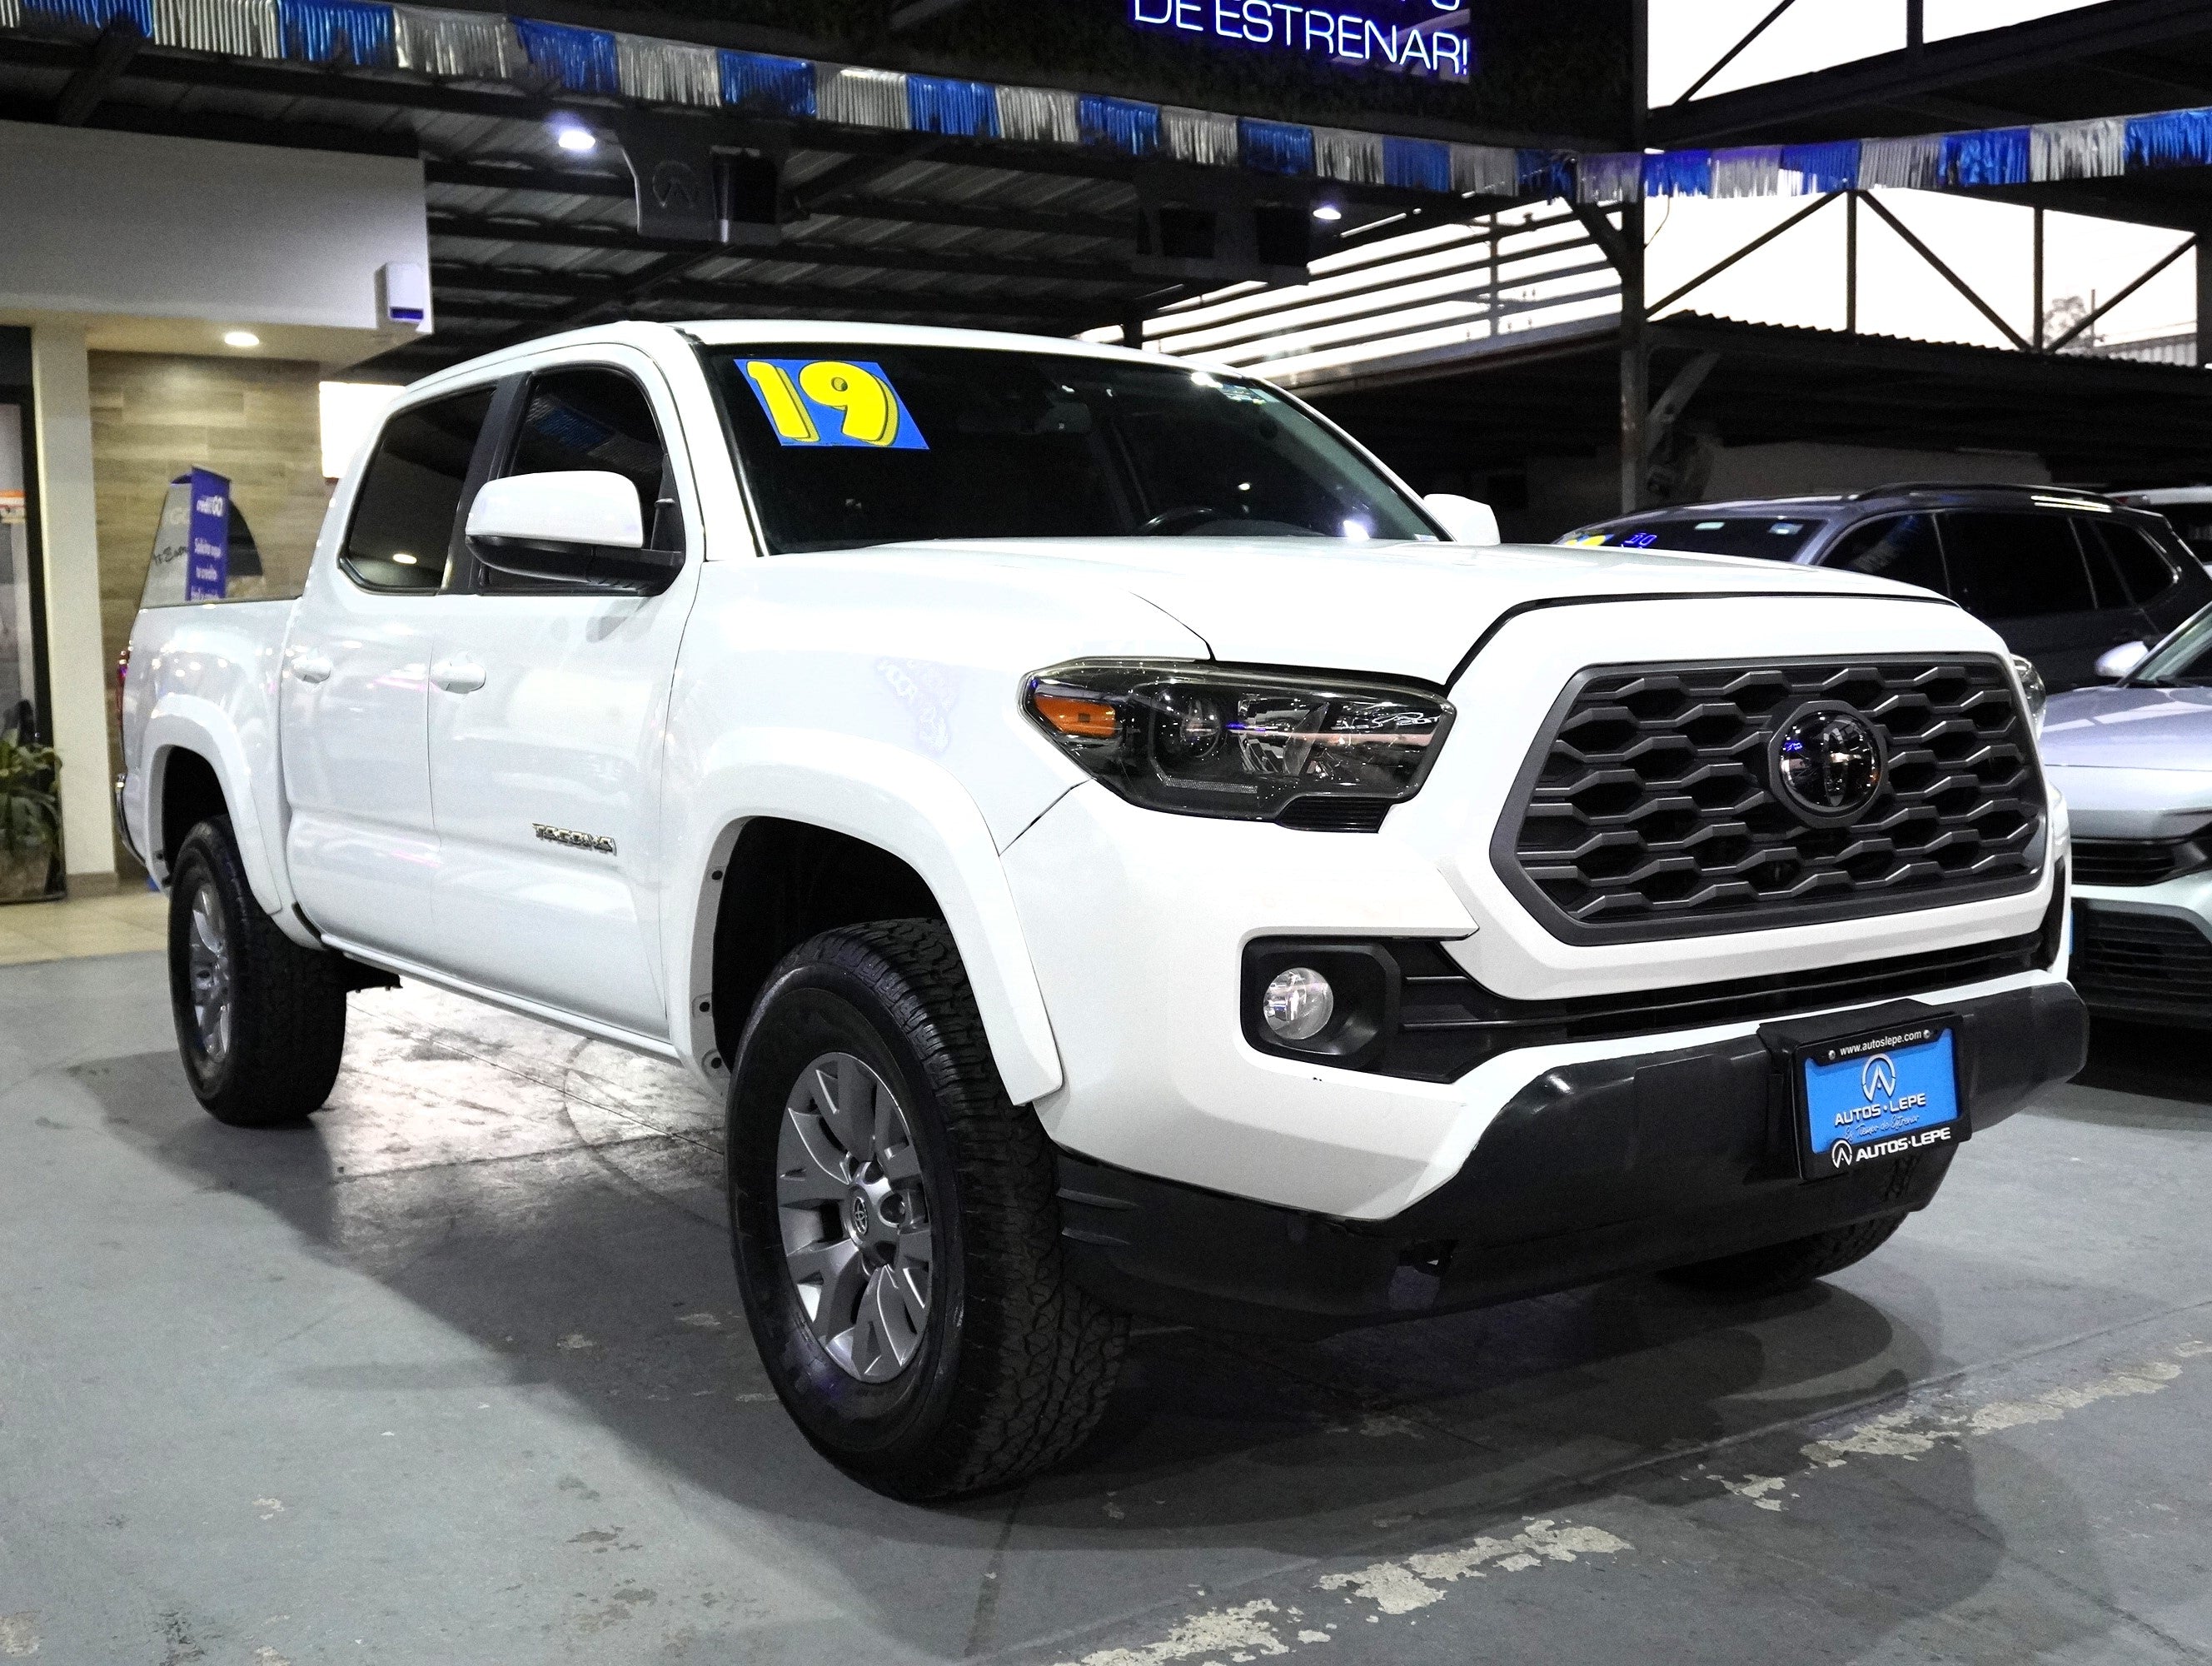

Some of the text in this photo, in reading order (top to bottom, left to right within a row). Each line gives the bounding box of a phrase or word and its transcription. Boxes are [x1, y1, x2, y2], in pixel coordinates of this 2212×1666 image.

[1134, 0, 1469, 75] DE ESTRENAR!
[746, 361, 899, 447] 19
[1840, 1030, 1922, 1055] www.autoslepe.com
